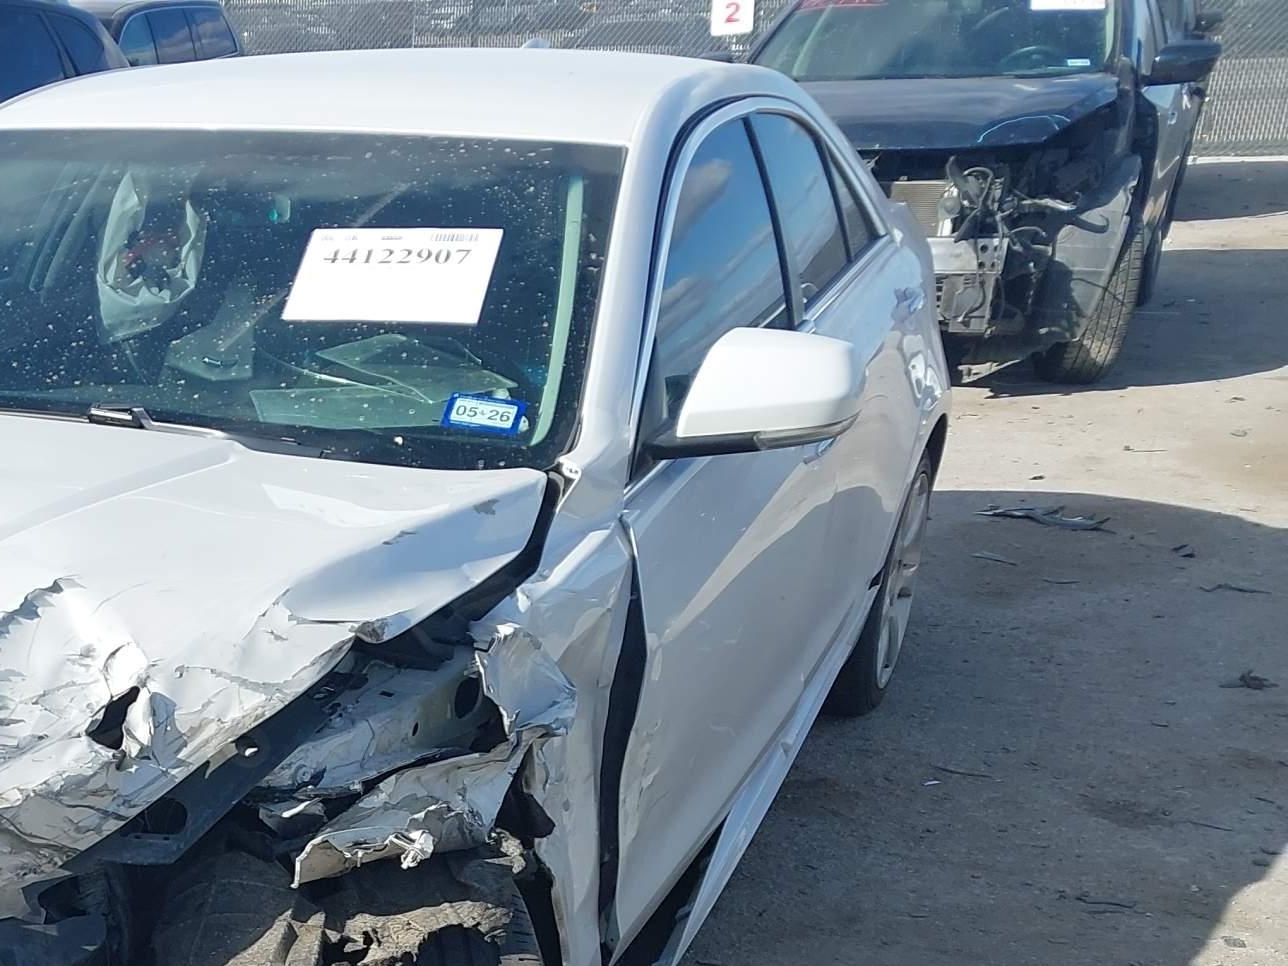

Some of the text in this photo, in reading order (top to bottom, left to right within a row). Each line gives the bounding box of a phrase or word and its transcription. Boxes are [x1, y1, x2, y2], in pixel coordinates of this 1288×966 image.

[725, 2, 740, 23] 2
[322, 247, 473, 265] 44122907
[455, 404, 512, 422] 05 26
